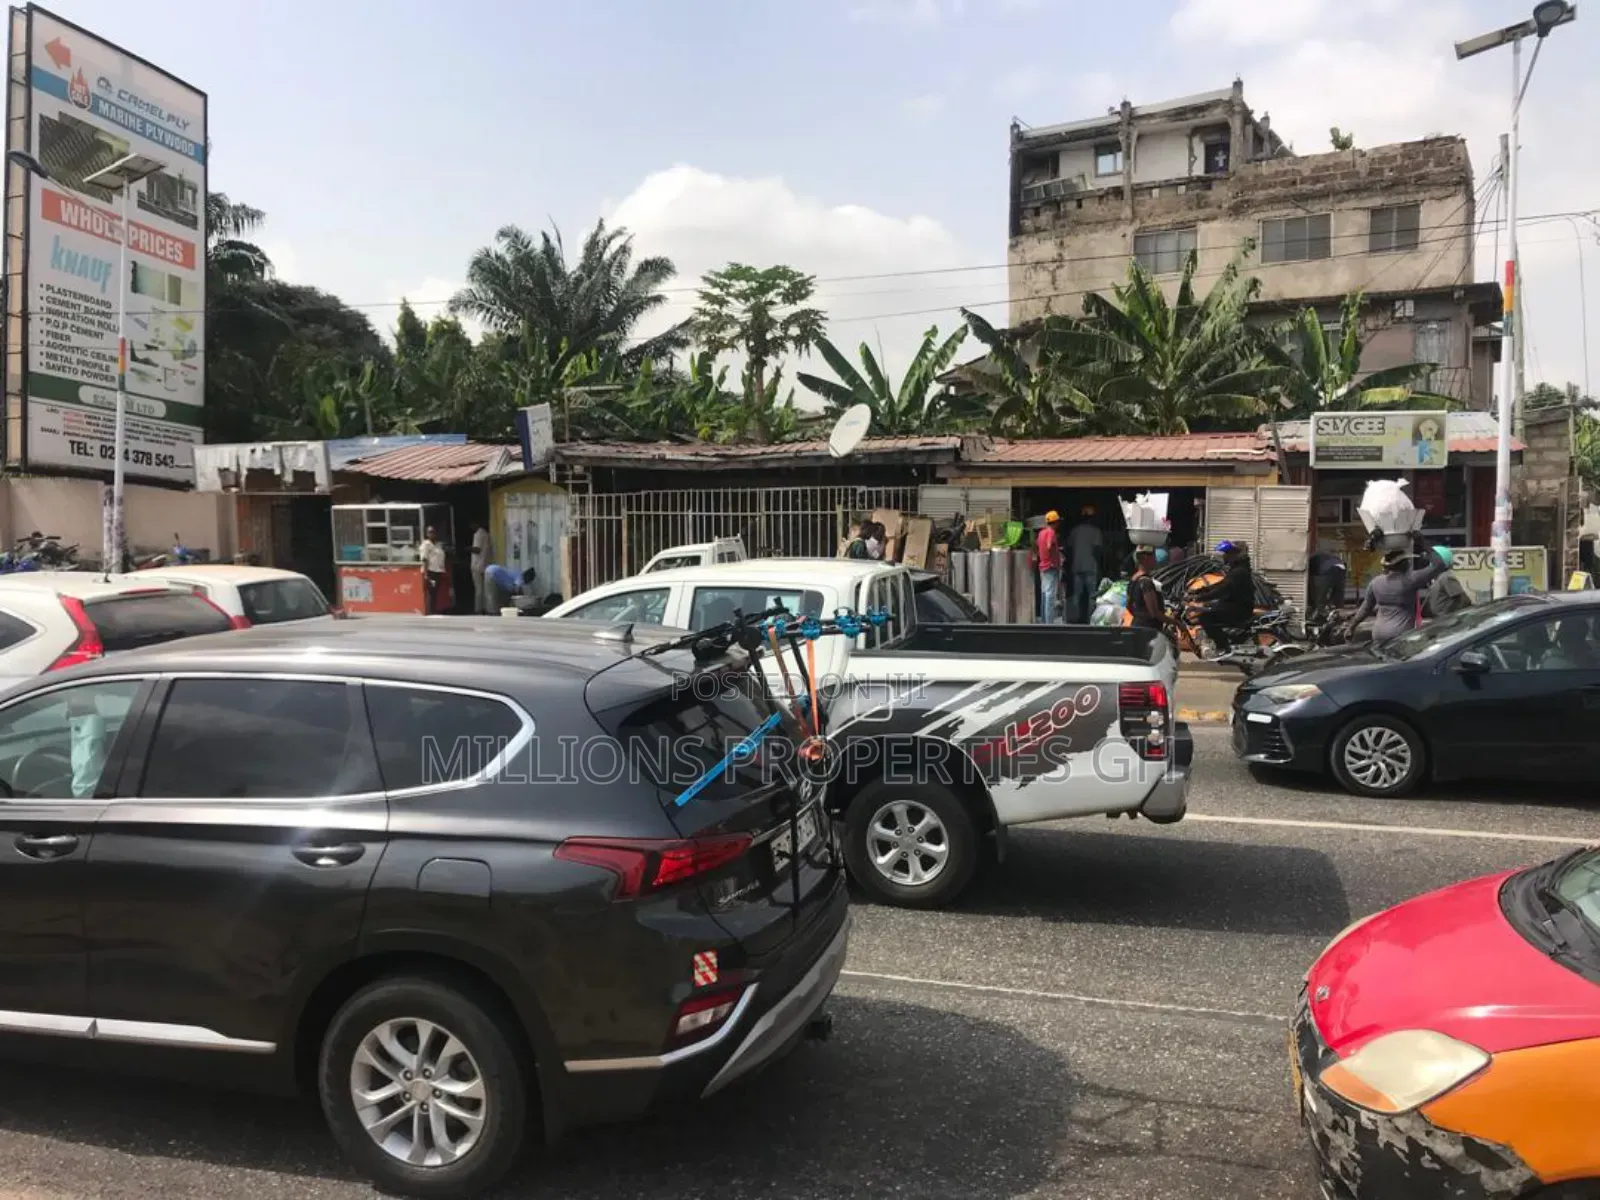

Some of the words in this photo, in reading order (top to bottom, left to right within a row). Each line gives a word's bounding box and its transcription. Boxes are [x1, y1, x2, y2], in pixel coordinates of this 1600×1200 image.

[98, 99, 143, 132] MARINE
[145, 122, 195, 156] PLYWOOD
[128, 224, 184, 262] PRICES
[46, 283, 112, 309] PLASTERBOARD
[46, 295, 81, 311] CEMENT
[84, 305, 112, 320] BOARD
[46, 306, 95, 327] INSULATION
[46, 329, 71, 342] FIBER
[70, 323, 104, 340] CEMENT
[46, 351, 73, 366] METAL
[76, 358, 111, 373] PROFILE
[81, 368, 116, 384] POWDER
[69, 440, 94, 457] TEL:
[132, 449, 152, 467] 378
[154, 453, 175, 469] 543
[1004, 685, 1102, 756] L200
